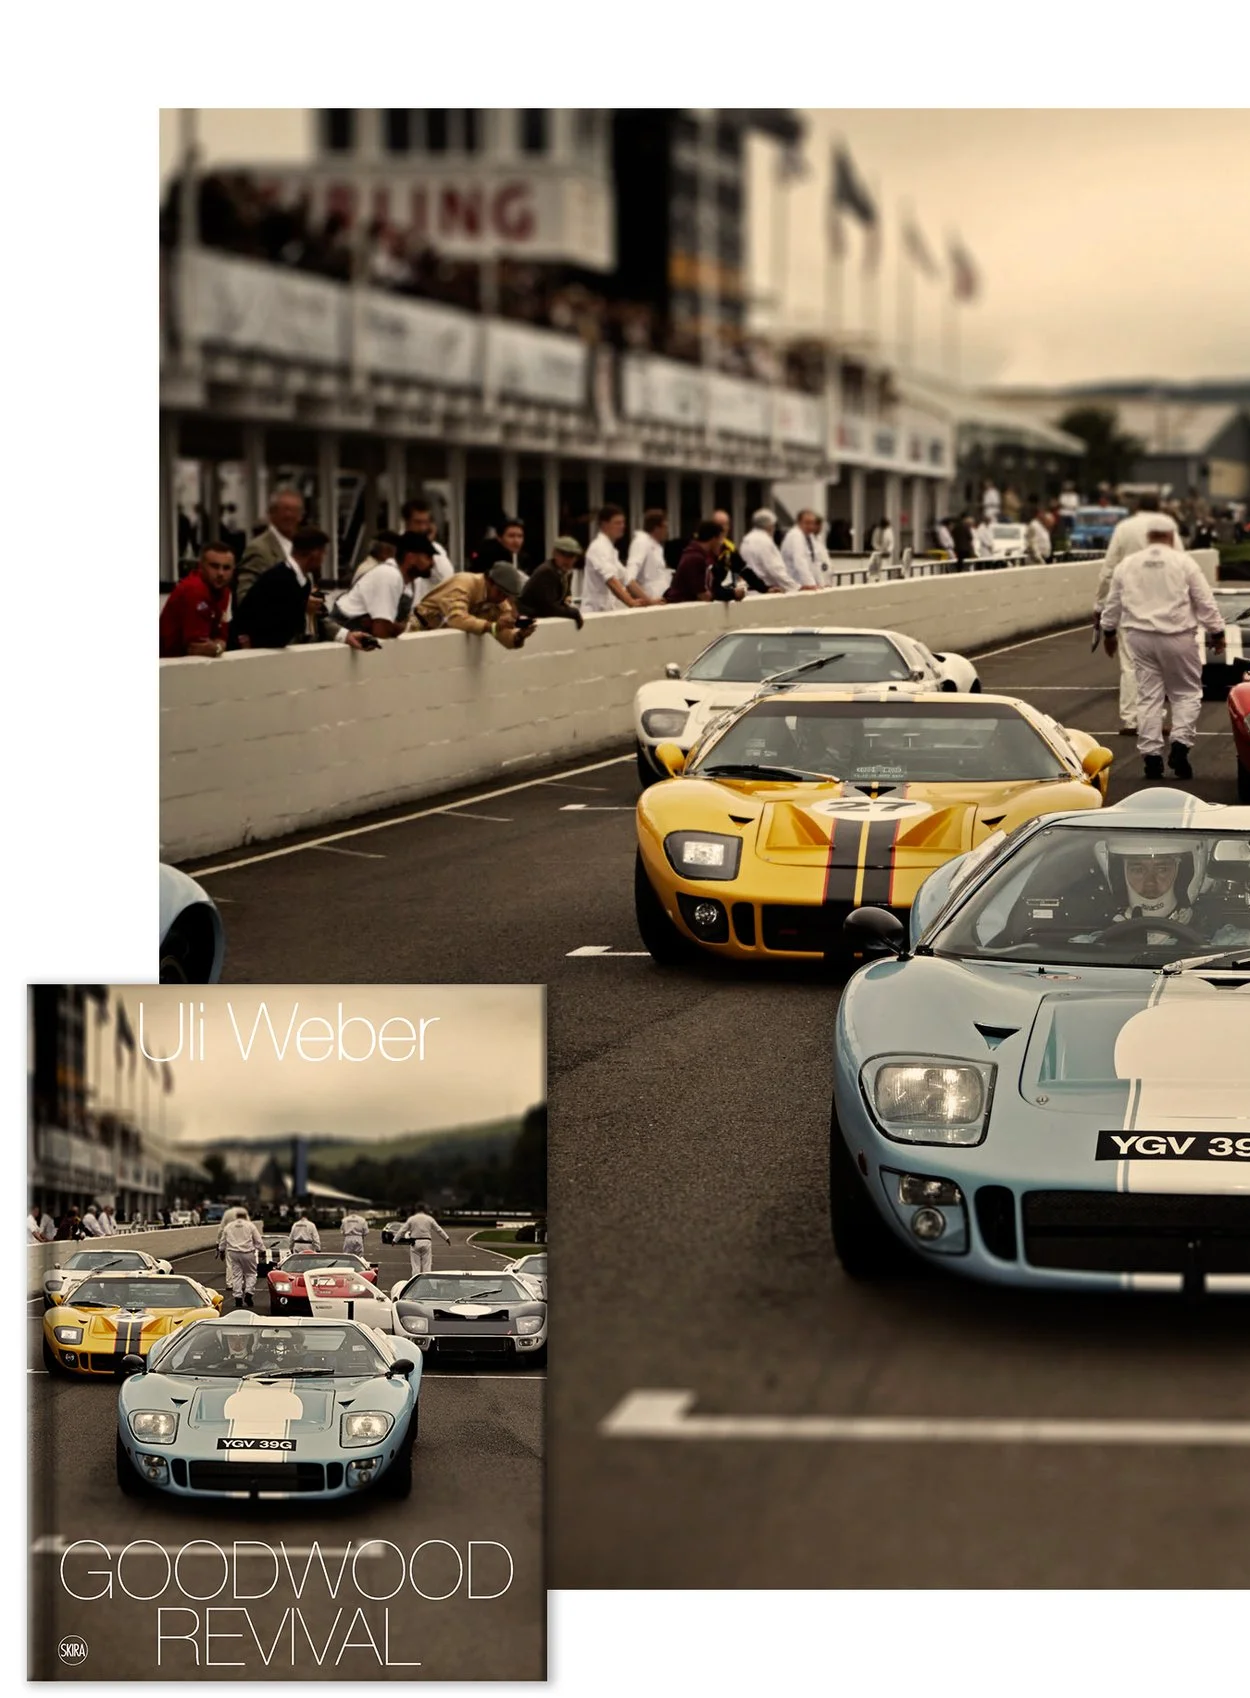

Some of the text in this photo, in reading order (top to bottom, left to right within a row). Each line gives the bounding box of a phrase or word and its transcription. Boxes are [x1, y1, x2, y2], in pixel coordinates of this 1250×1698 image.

[827, 801, 916, 813] 27
[139, 1001, 441, 1062] Uli Weber
[1110, 1135, 1196, 1155] YGV
[222, 1439, 292, 1450] YGV 39G
[59, 1539, 515, 1601] GOODWOOD
[157, 1607, 422, 1666] REVIVAL
[60, 1643, 86, 1657] SKIRA
